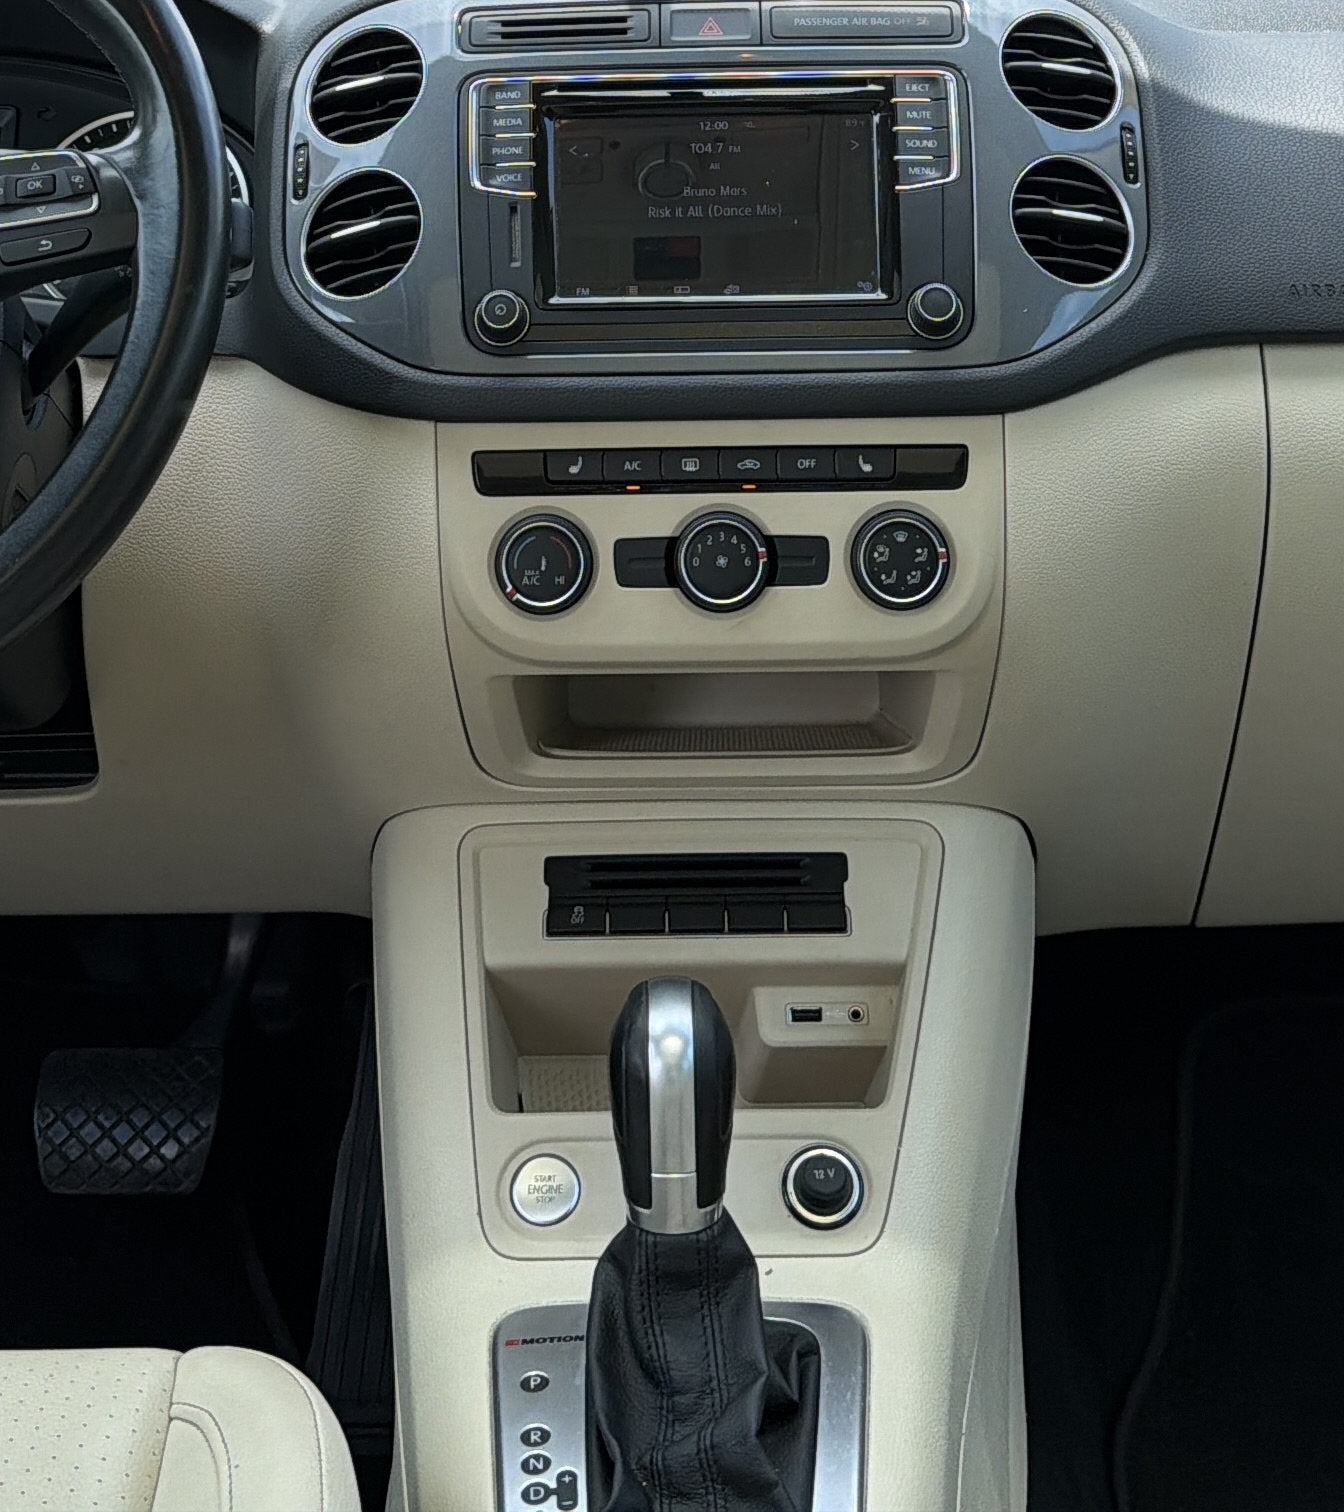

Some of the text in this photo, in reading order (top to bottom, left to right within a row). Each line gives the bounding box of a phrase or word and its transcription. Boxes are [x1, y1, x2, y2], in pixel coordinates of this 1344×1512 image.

[793, 16, 910, 26] PASSENGER AIR BAG OFF
[905, 83, 930, 92] EJECT
[495, 90, 521, 100] BAND
[906, 110, 932, 119] MUTE
[492, 117, 523, 128] MEDIA
[698, 120, 730, 131] 12:00
[905, 138, 938, 148] SOUND
[491, 145, 523, 155] PHONE
[908, 166, 936, 175] MENU
[495, 173, 523, 183] VOICE
[26, 179, 44, 191] OK
[683, 185, 749, 197] Bruno Mars
[647, 203, 784, 218] Risk it All (Dance Mix)
[623, 460, 642, 471] A/C
[797, 458, 817, 470] OFF
[706, 535, 713, 546] 2
[719, 532, 725, 542] 3
[730, 535, 738, 545] 4
[697, 543, 702, 554] 1
[740, 544, 747, 554] 5
[692, 557, 700, 567] 0
[744, 557, 752, 567] 6
[521, 575, 541, 586] A/C
[533, 1174, 556, 1183] START
[813, 1168, 835, 1179] 12 V
[527, 1184, 564, 1195] ENGINE
[529, 1376, 541, 1390] P
[530, 1430, 543, 1443] R
[529, 1456, 544, 1471] N
[529, 1486, 545, 1501] D
